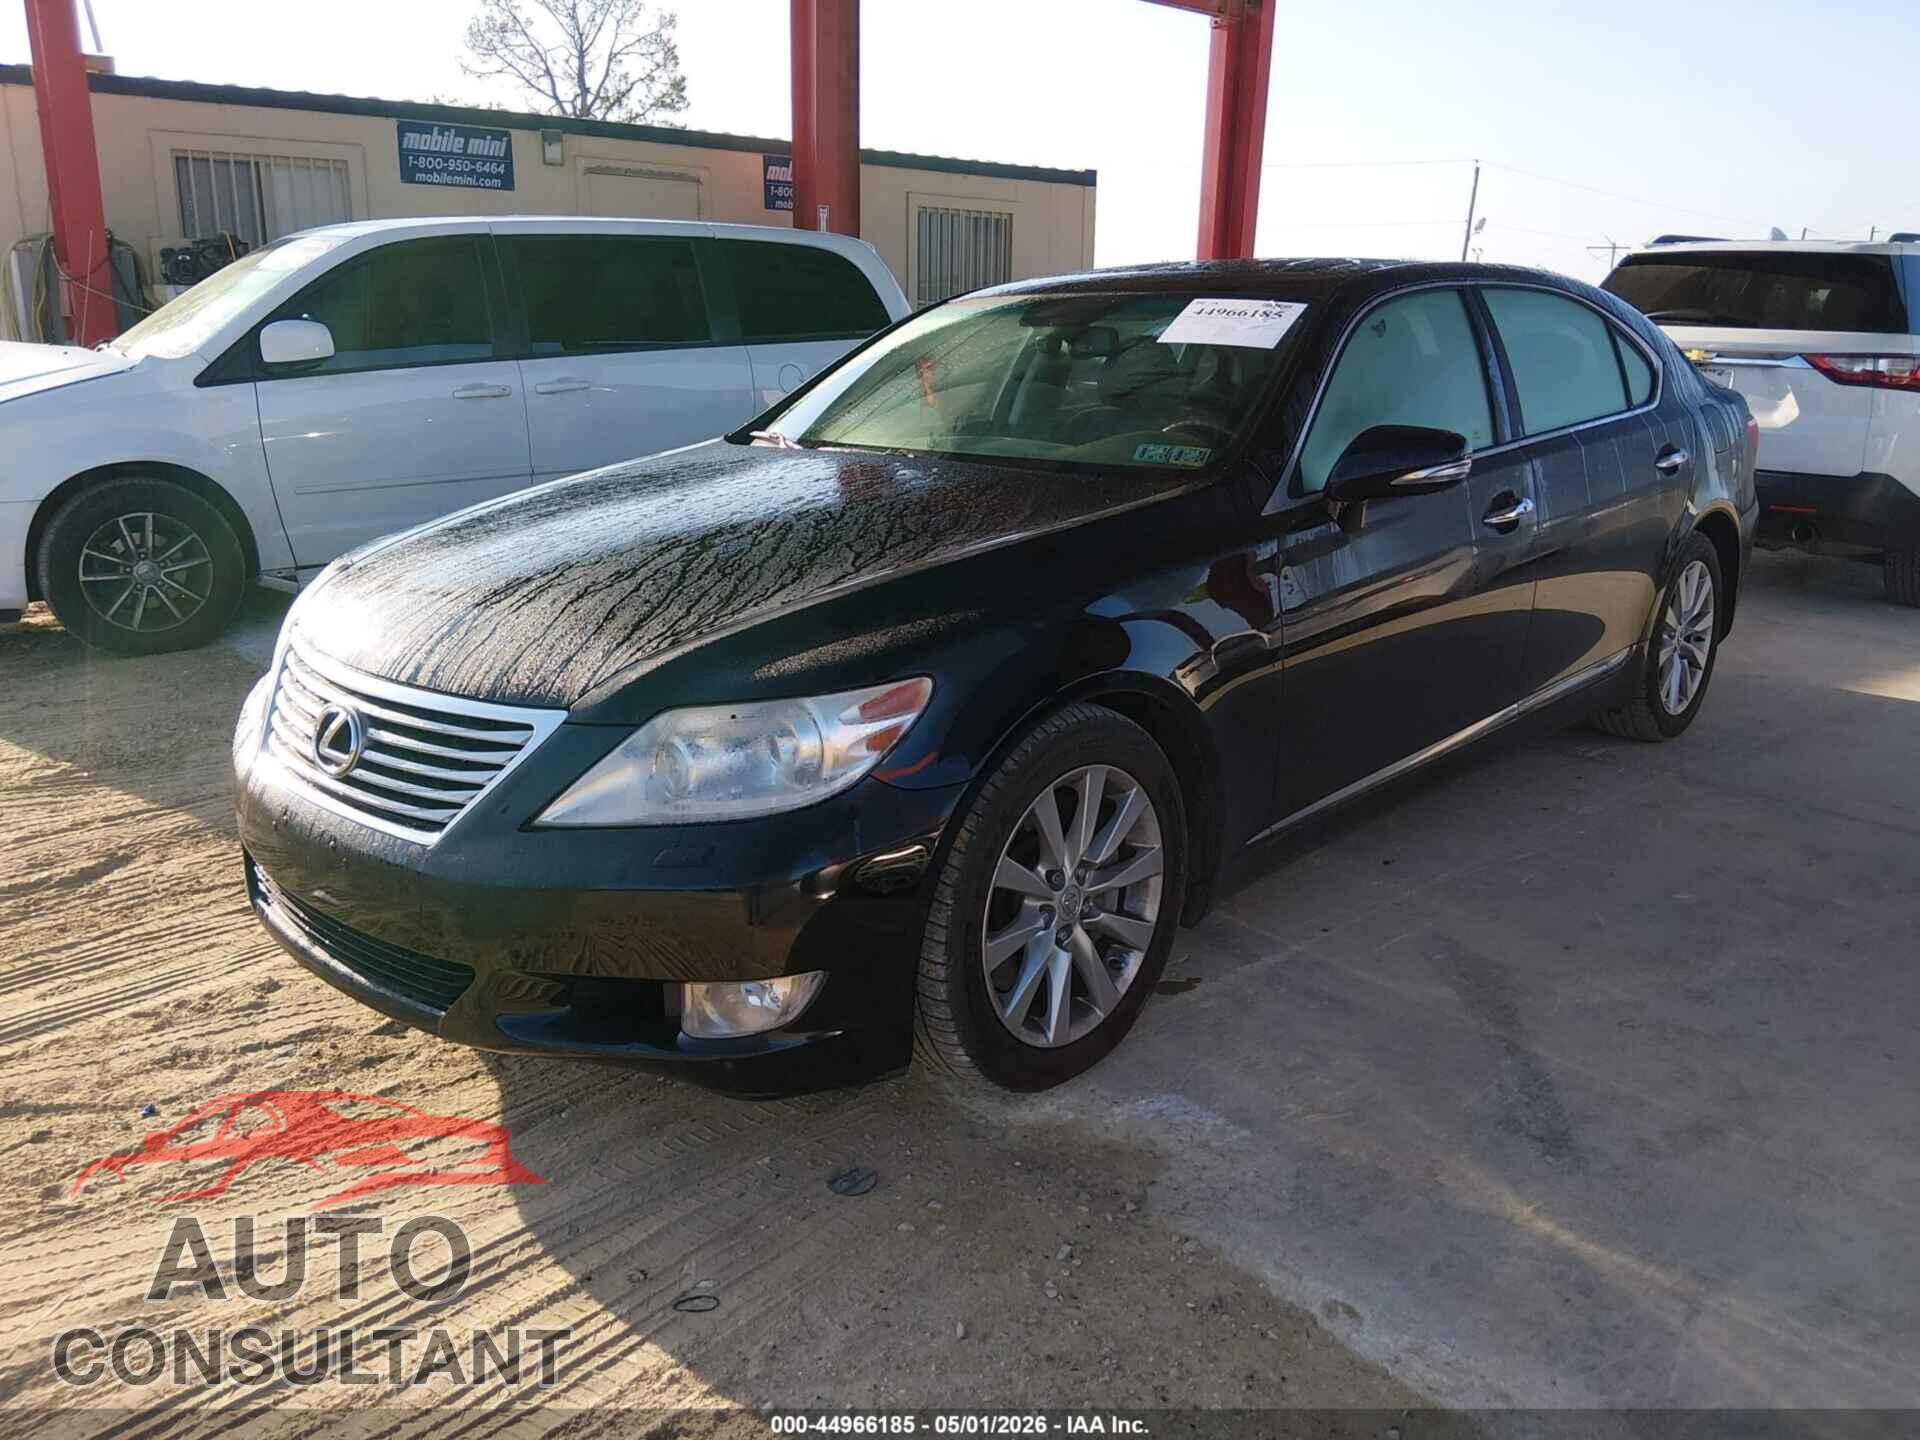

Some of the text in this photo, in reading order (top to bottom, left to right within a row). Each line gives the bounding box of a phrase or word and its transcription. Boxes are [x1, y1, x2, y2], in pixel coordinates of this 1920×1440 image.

[402, 126, 509, 157] mobile mini
[408, 155, 505, 174] 1-800-950-6464
[415, 172, 502, 188] mobilemini.com
